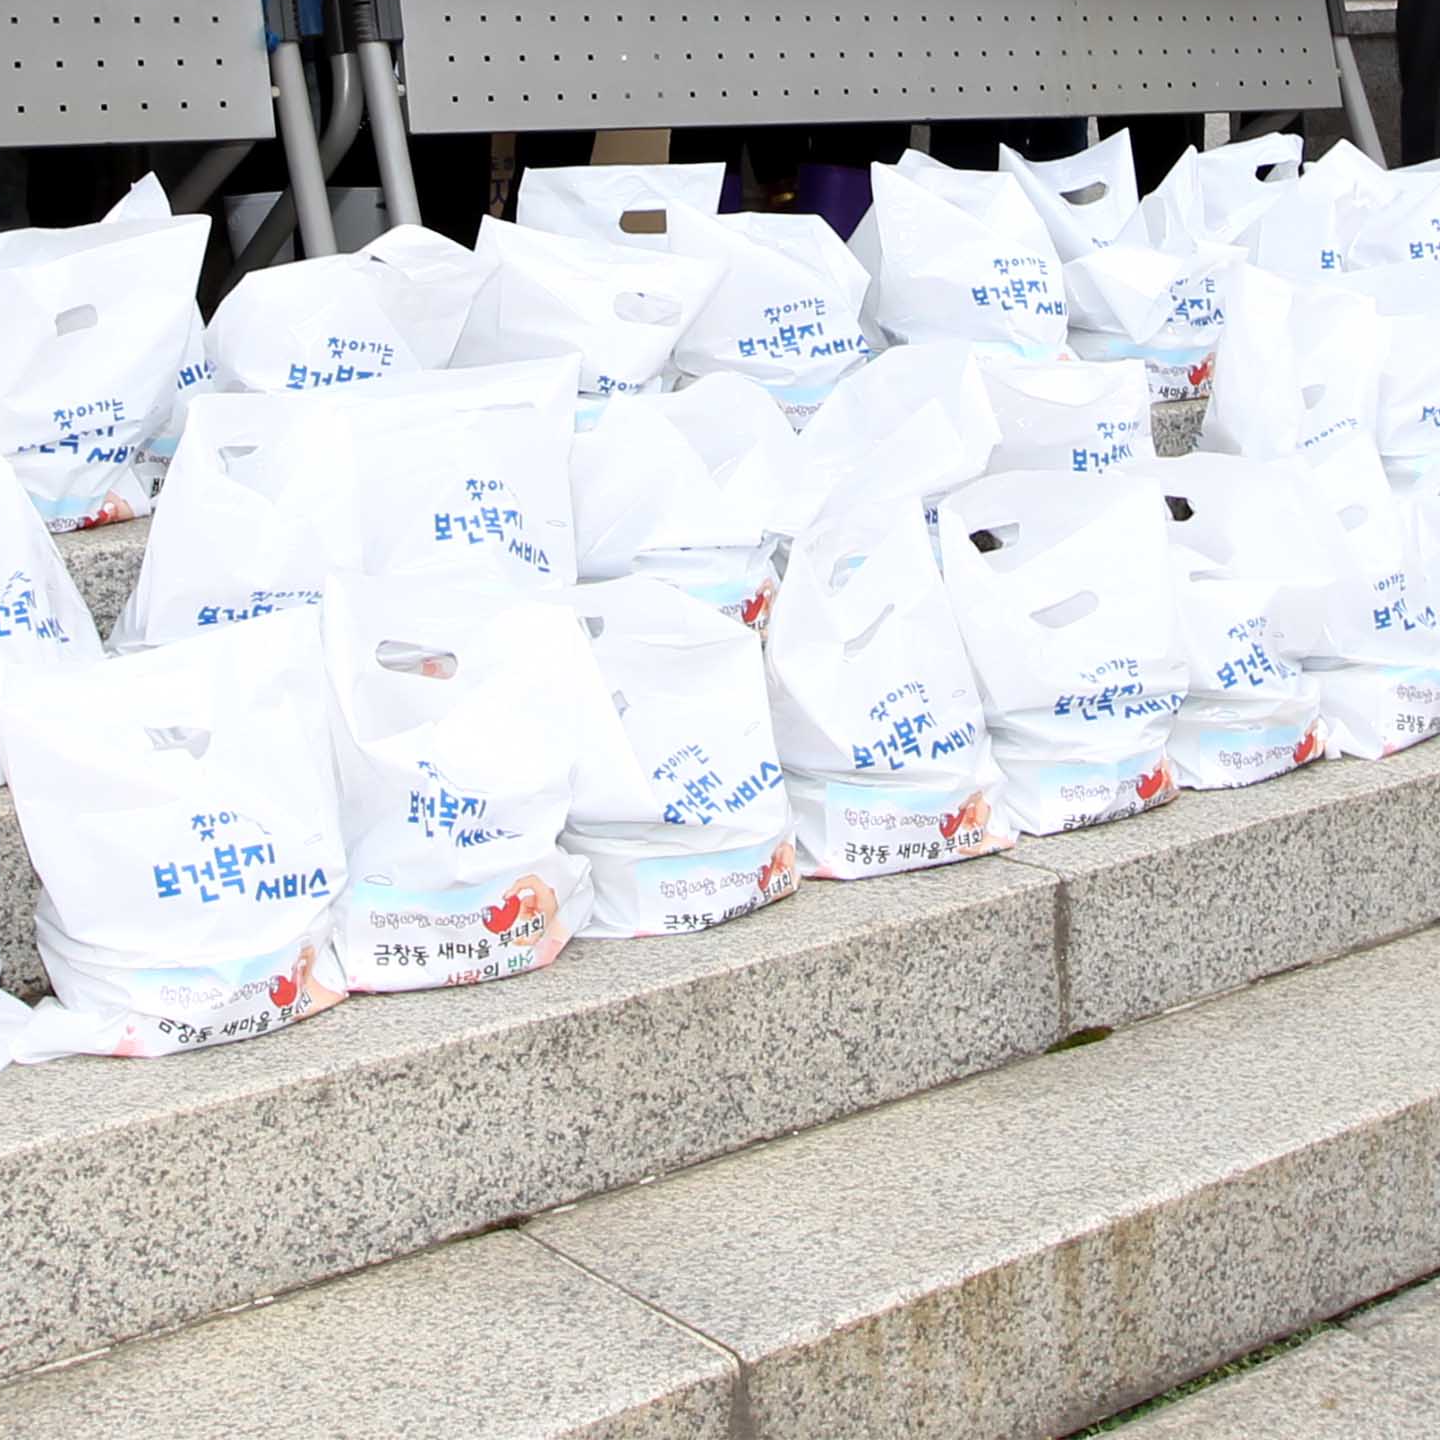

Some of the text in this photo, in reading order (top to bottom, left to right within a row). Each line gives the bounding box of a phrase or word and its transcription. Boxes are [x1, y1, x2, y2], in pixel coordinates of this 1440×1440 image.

[763, 297, 827, 325] 찾아가는
[972, 279, 1068, 317] 보건복지 서비
[327, 336, 395, 367] 찾아가는
[737, 321, 824, 359] 보건복지
[53, 397, 126, 431] 찾아가는
[465, 477, 504, 501] 찾아
[433, 506, 524, 545] 보건복지
[508, 537, 551, 573] 서비스
[1053, 681, 1144, 721] 보건복지
[852, 711, 937, 771] 보건복지
[724, 760, 785, 814] 서비스
[190, 810, 239, 842] 찾아
[843, 828, 985, 865] 금창동 새마을 부녀회
[152, 842, 331, 904] 보건복지 서비스
[373, 913, 546, 967] 금창동 새마을 부녀회
[220, 1010, 273, 1038] 새마을
